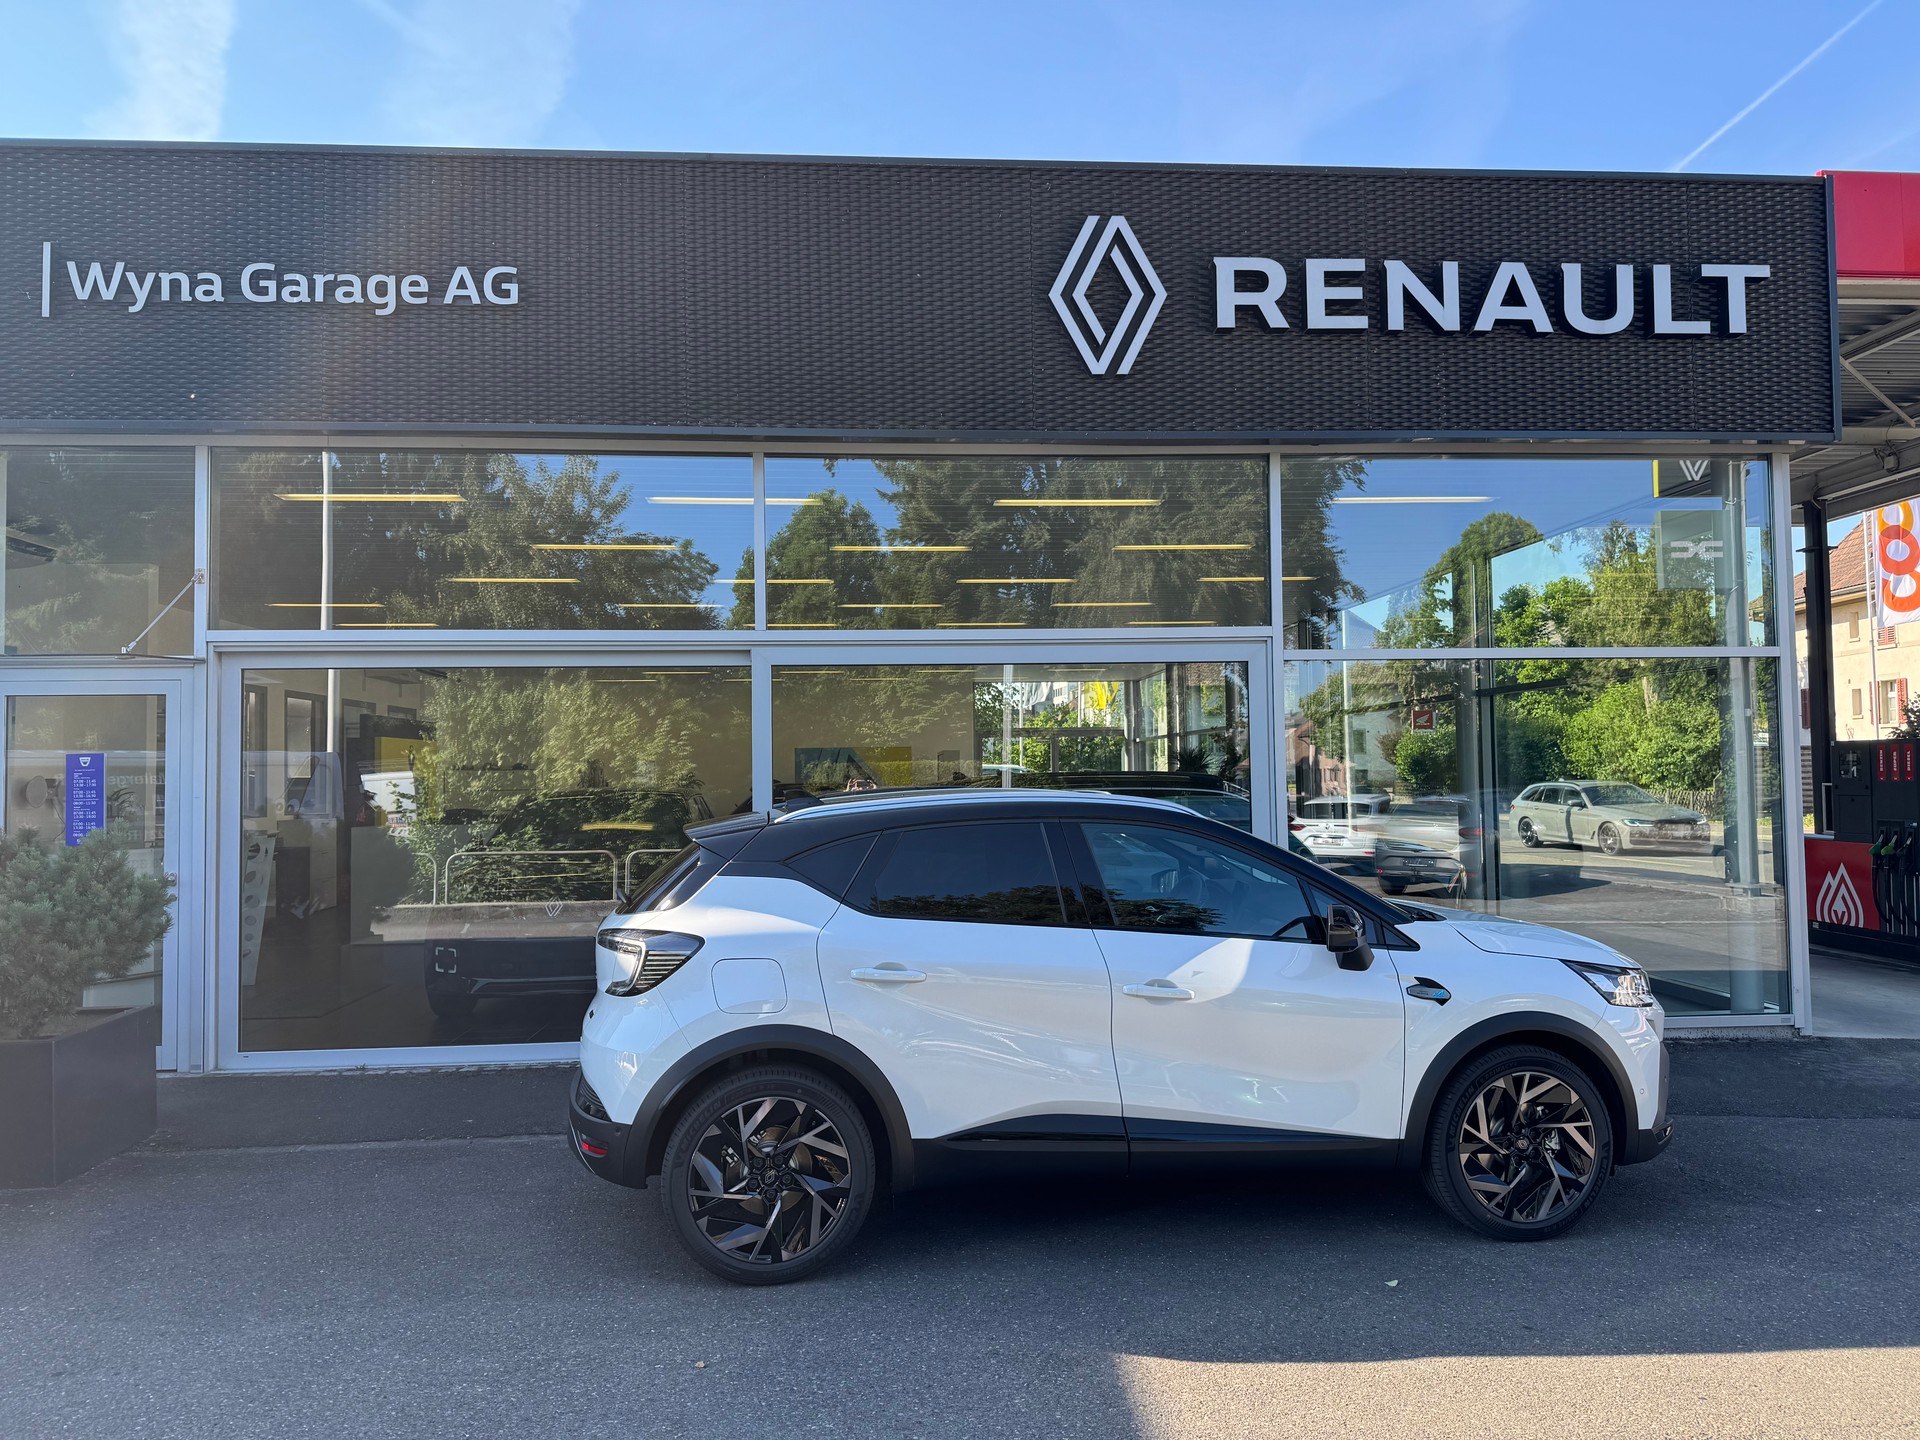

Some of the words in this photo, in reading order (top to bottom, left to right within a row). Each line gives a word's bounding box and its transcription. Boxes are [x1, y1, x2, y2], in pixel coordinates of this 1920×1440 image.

[66, 261, 224, 313] Wyna
[240, 262, 429, 316] Garage
[443, 265, 521, 305] AG
[1212, 256, 1771, 335] RENAULT
[1851, 765, 1857, 777] 1
[679, 1096, 722, 1151] MICHELIN
[1448, 1085, 1475, 1137] MICHELIN
[1583, 1158, 1608, 1209] MICHELIN
